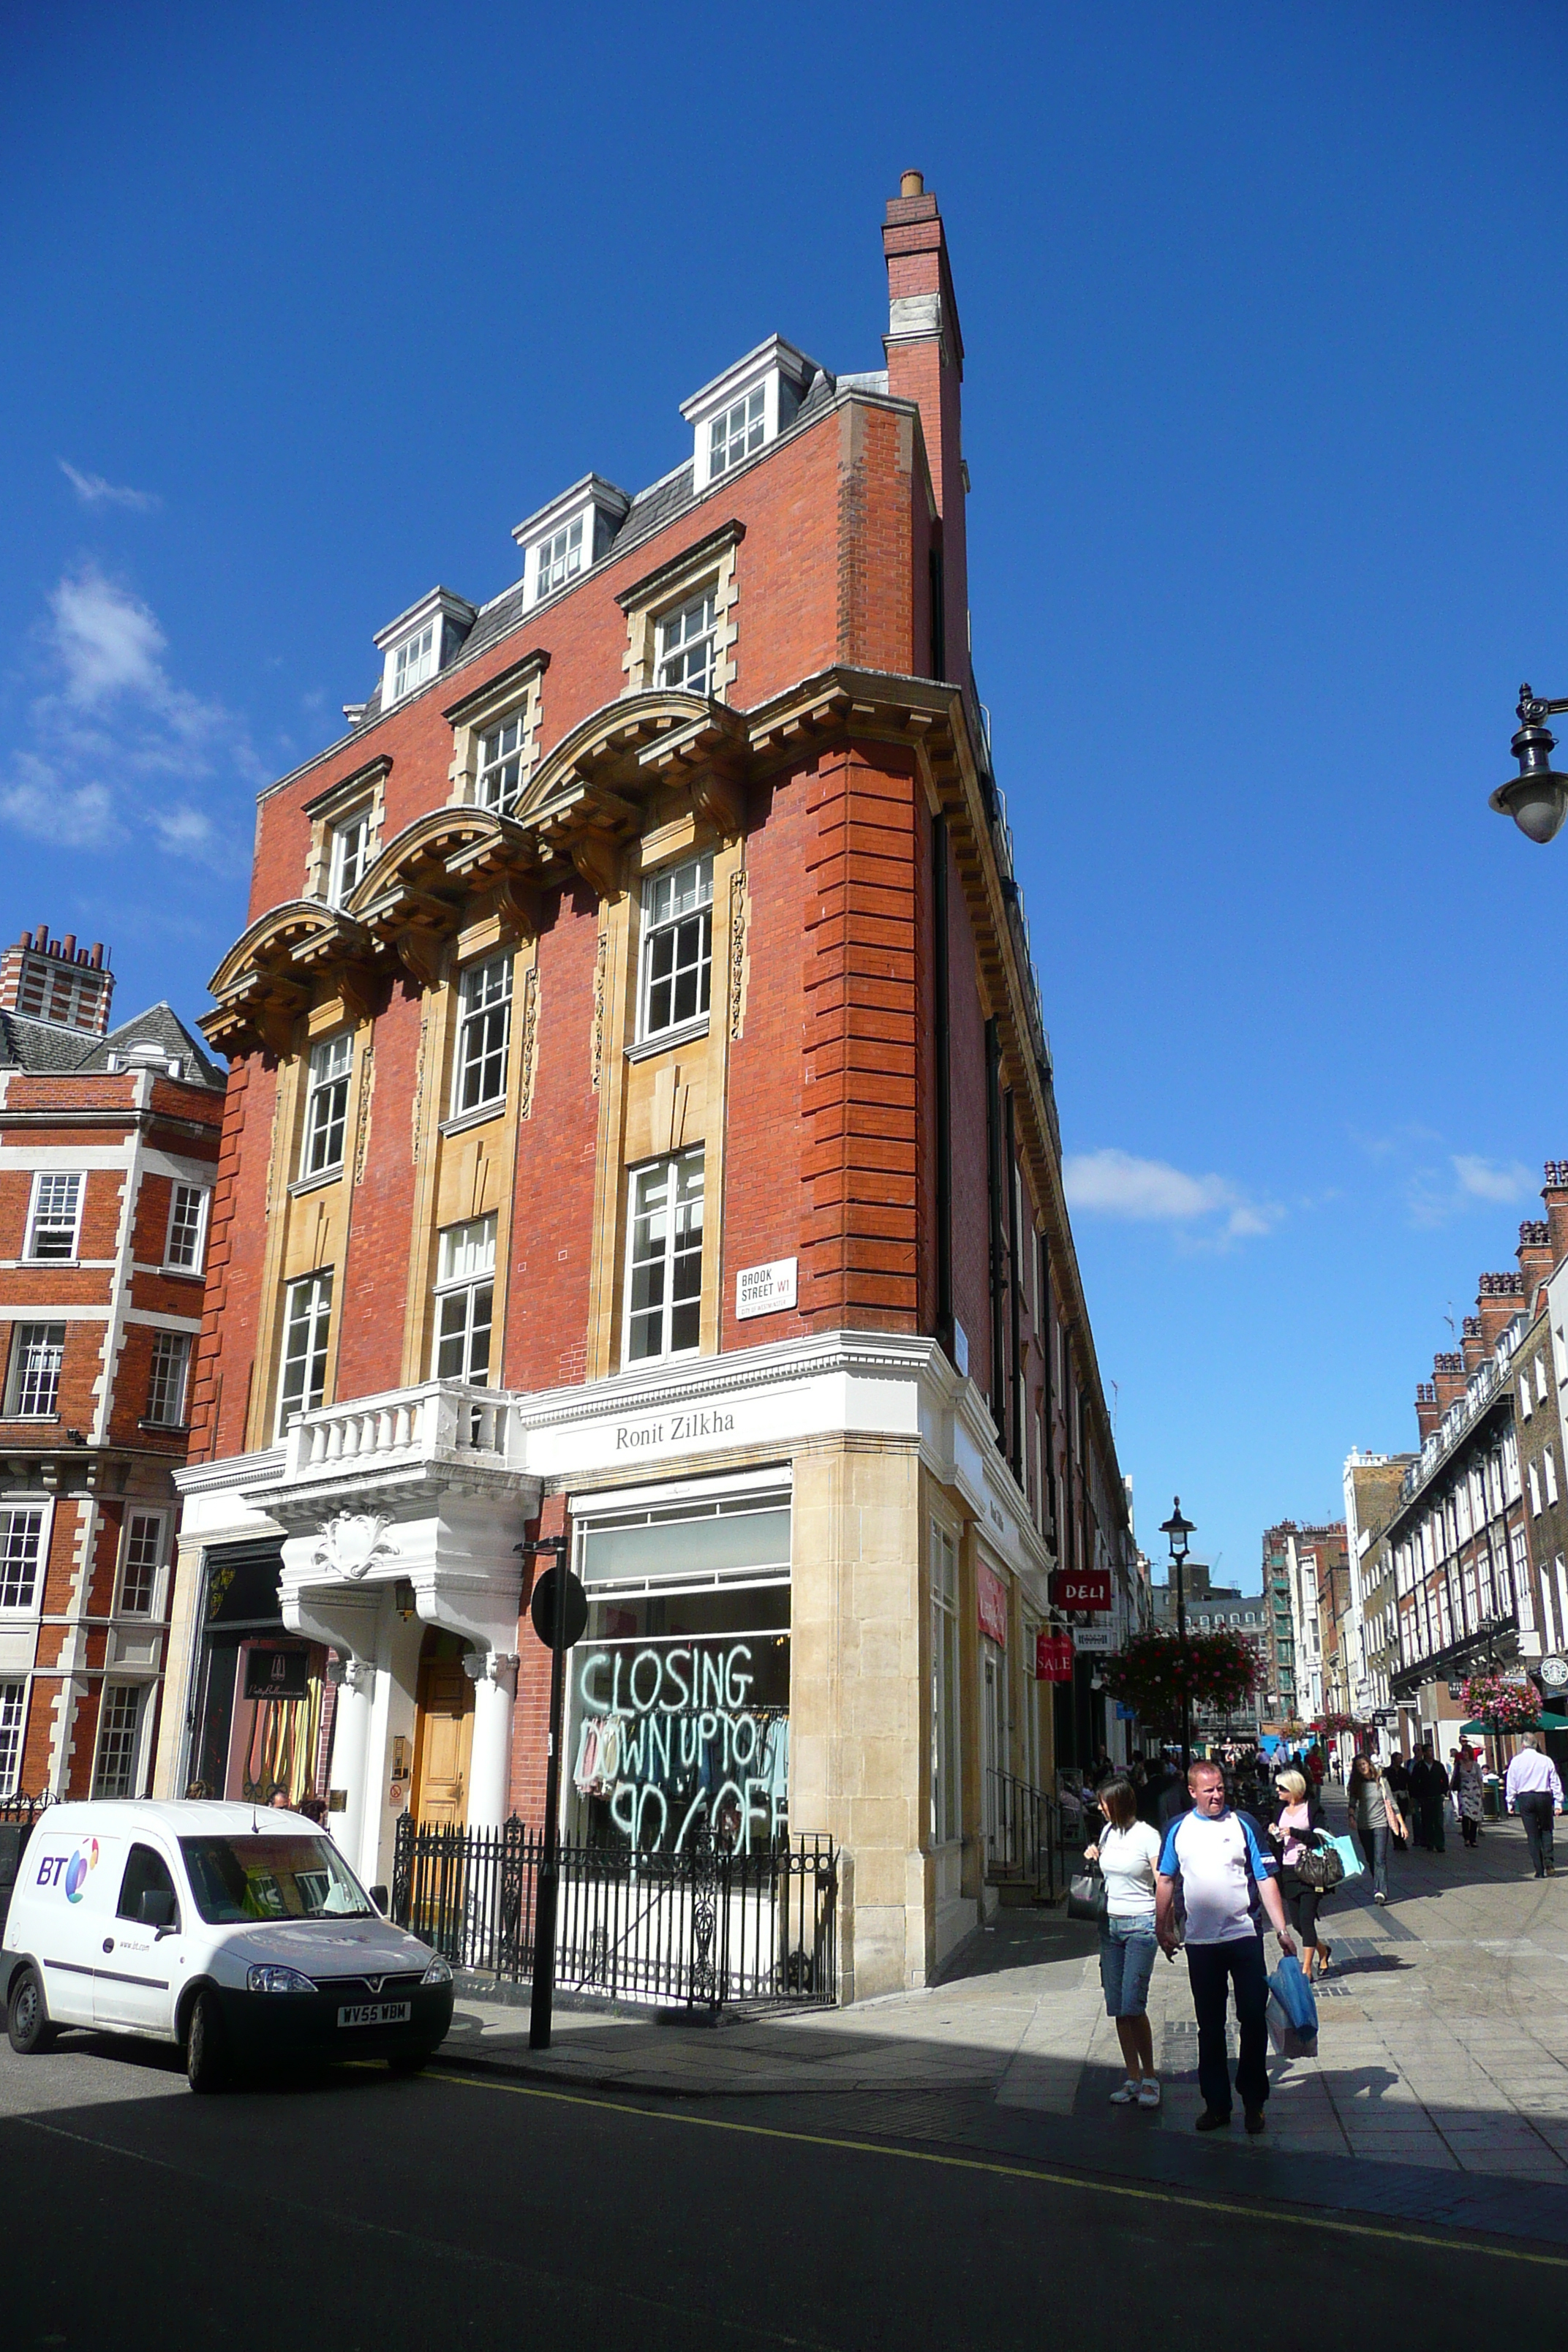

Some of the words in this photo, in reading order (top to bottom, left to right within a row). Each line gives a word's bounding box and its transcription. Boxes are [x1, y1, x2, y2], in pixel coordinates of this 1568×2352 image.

[742, 1267, 772, 1287] BROOK
[741, 1282, 774, 1302] STREET
[777, 1278, 790, 1293] W1
[741, 1307, 750, 1315] CITY
[751, 1305, 756, 1313] OF
[757, 1299, 786, 1311] WESTMINSTER
[616, 1423, 663, 1450] Ronit
[671, 1410, 735, 1440] Zilkha
[1065, 1584, 1105, 1600] DELI
[1037, 1656, 1071, 1671] SALE
[581, 1645, 753, 1718] CLOSING
[578, 1713, 671, 1784] DOWN
[37, 1857, 69, 1886] BT
[344, 2006, 378, 2023] WV55
